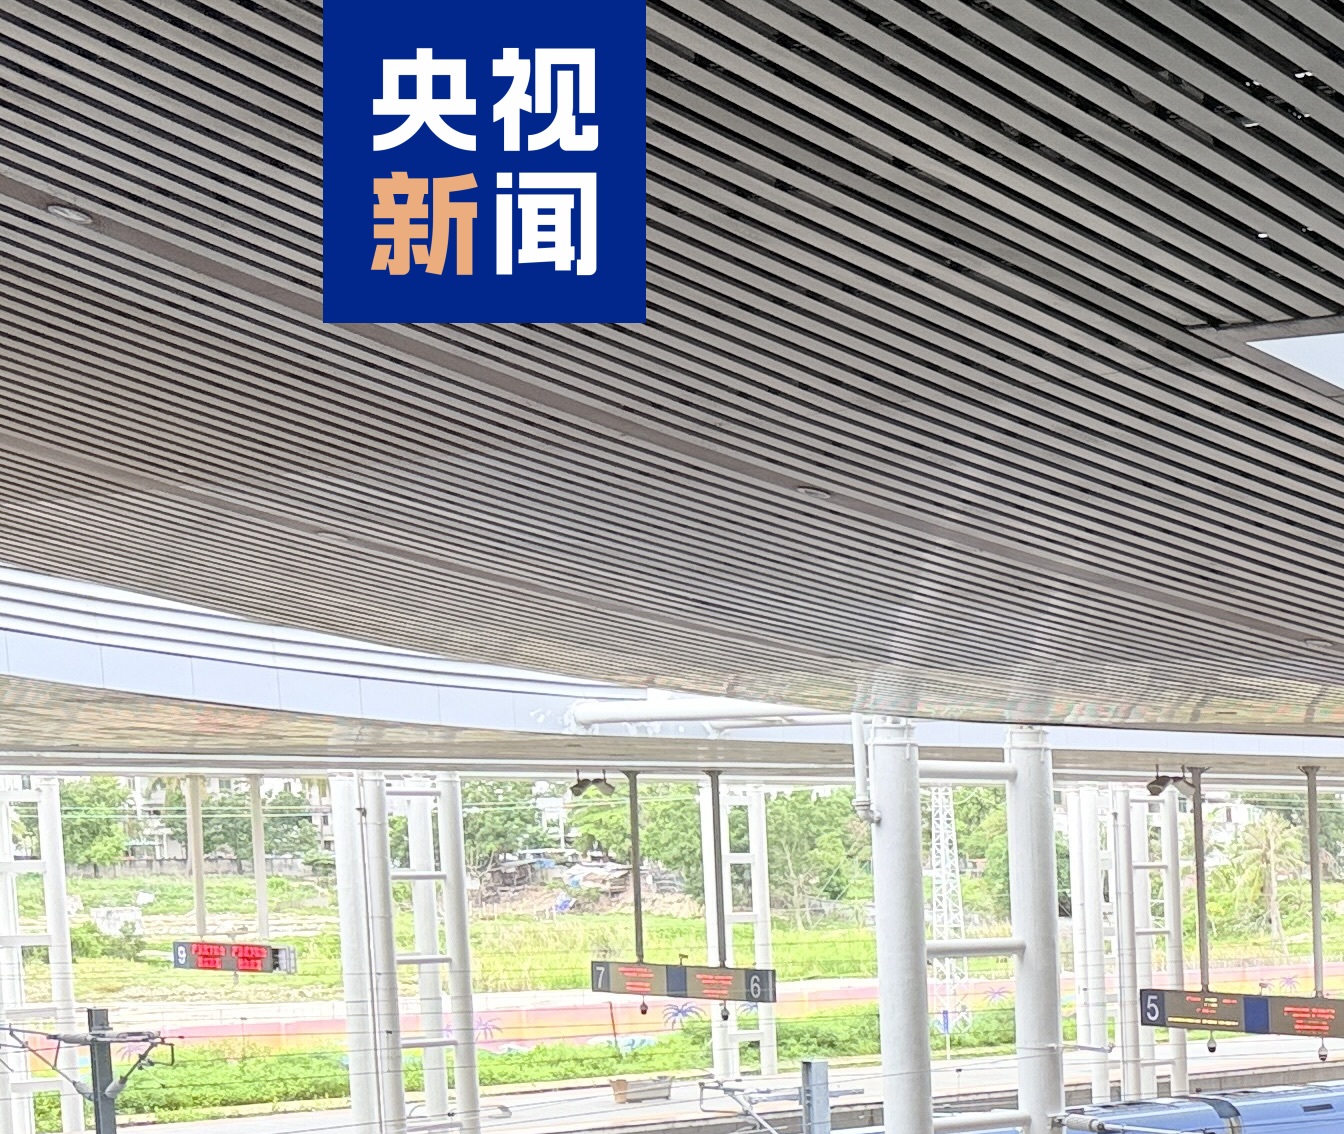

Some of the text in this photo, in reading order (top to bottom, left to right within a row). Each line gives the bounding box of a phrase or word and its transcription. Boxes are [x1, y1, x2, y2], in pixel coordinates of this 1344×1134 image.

[177, 945, 186, 964] 9
[595, 966, 605, 988] 7
[750, 974, 761, 998] 6
[1146, 995, 1160, 1021] 5
